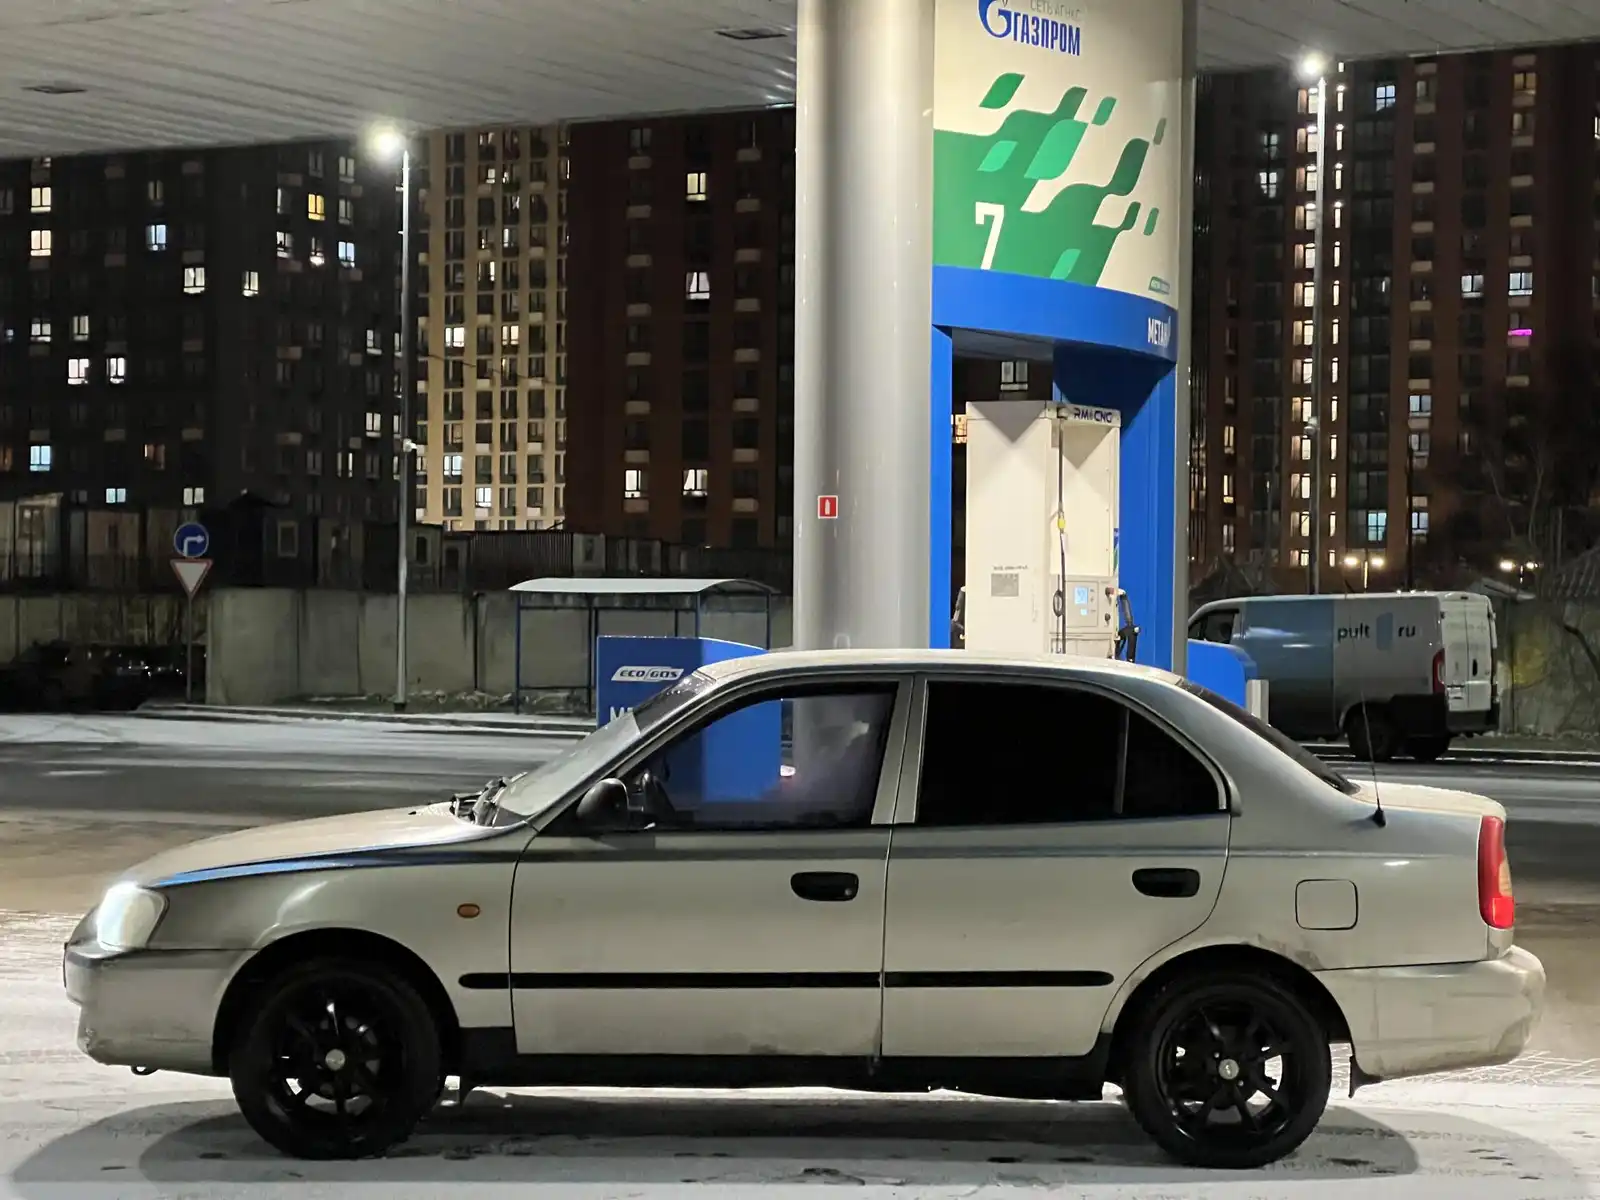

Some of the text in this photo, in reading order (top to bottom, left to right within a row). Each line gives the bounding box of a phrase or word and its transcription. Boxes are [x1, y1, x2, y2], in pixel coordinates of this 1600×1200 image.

[1013, 11, 1081, 56] ГАЗПРОМ
[975, 201, 1005, 270] 7
[1337, 622, 1416, 644] pult ru
